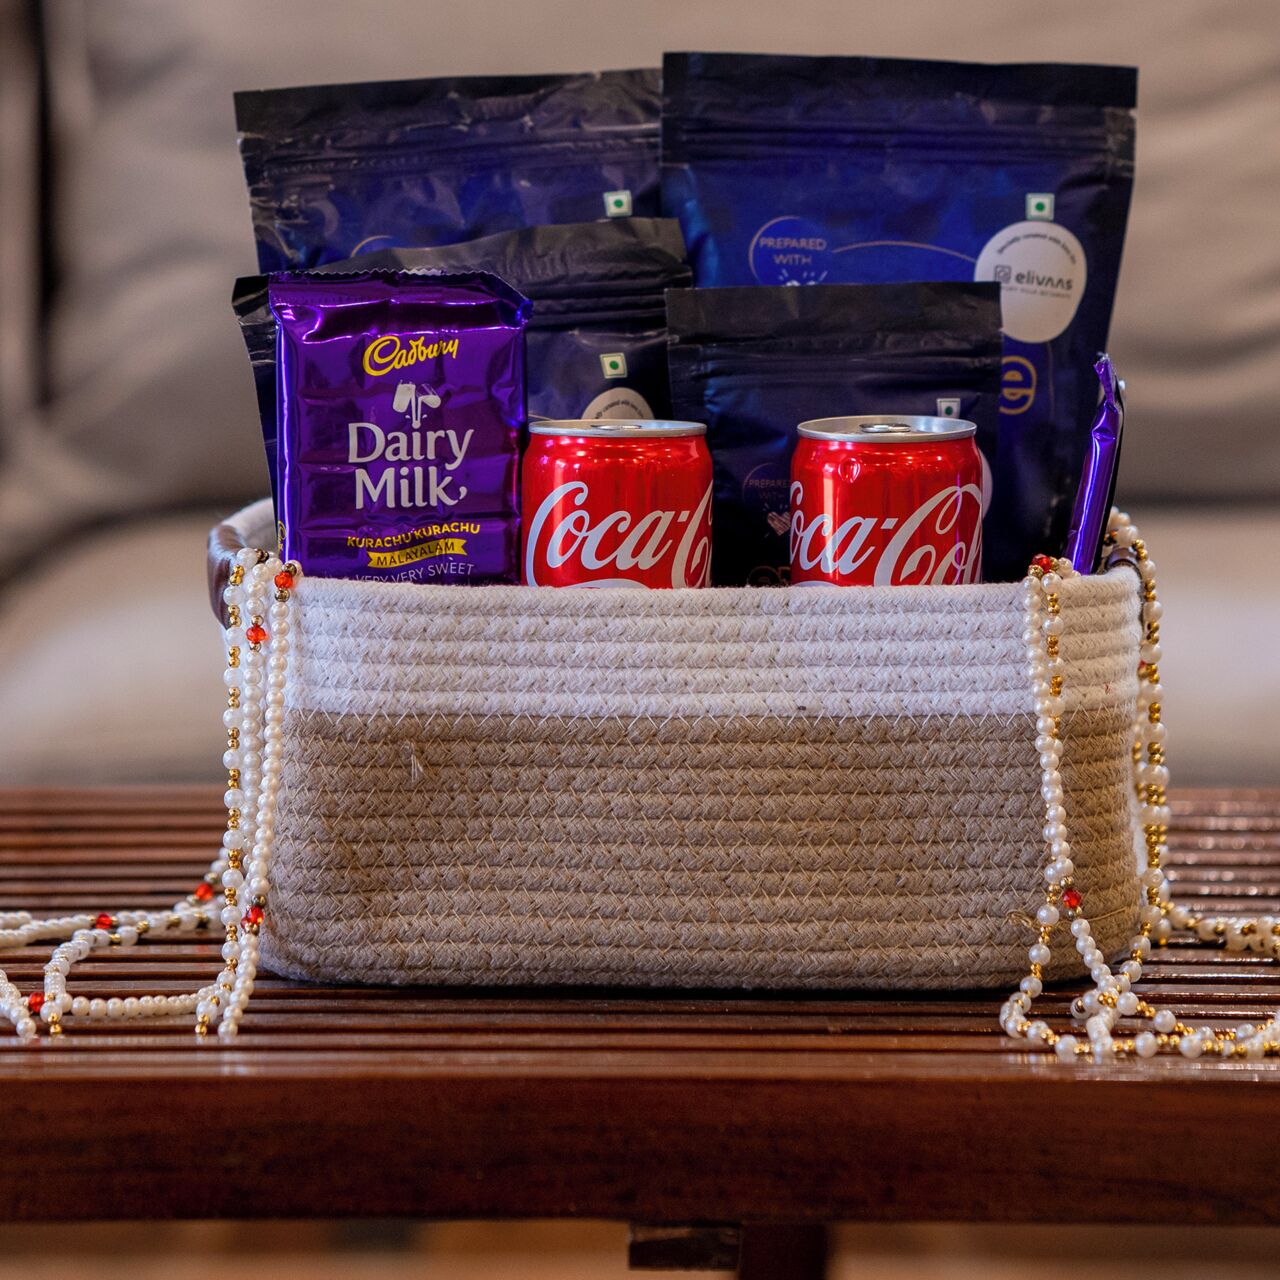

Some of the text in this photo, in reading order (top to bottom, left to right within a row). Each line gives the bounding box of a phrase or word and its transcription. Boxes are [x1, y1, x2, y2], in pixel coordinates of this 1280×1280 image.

[759, 237, 827, 251] PREPARED
[773, 254, 812, 265] WITH
[362, 335, 459, 376] Cadbury
[348, 422, 475, 471] Dairy
[346, 522, 481, 549] KURACHU KURACHU
[376, 541, 455, 567] MALAYALAM
[428, 562, 475, 577] SWEET
